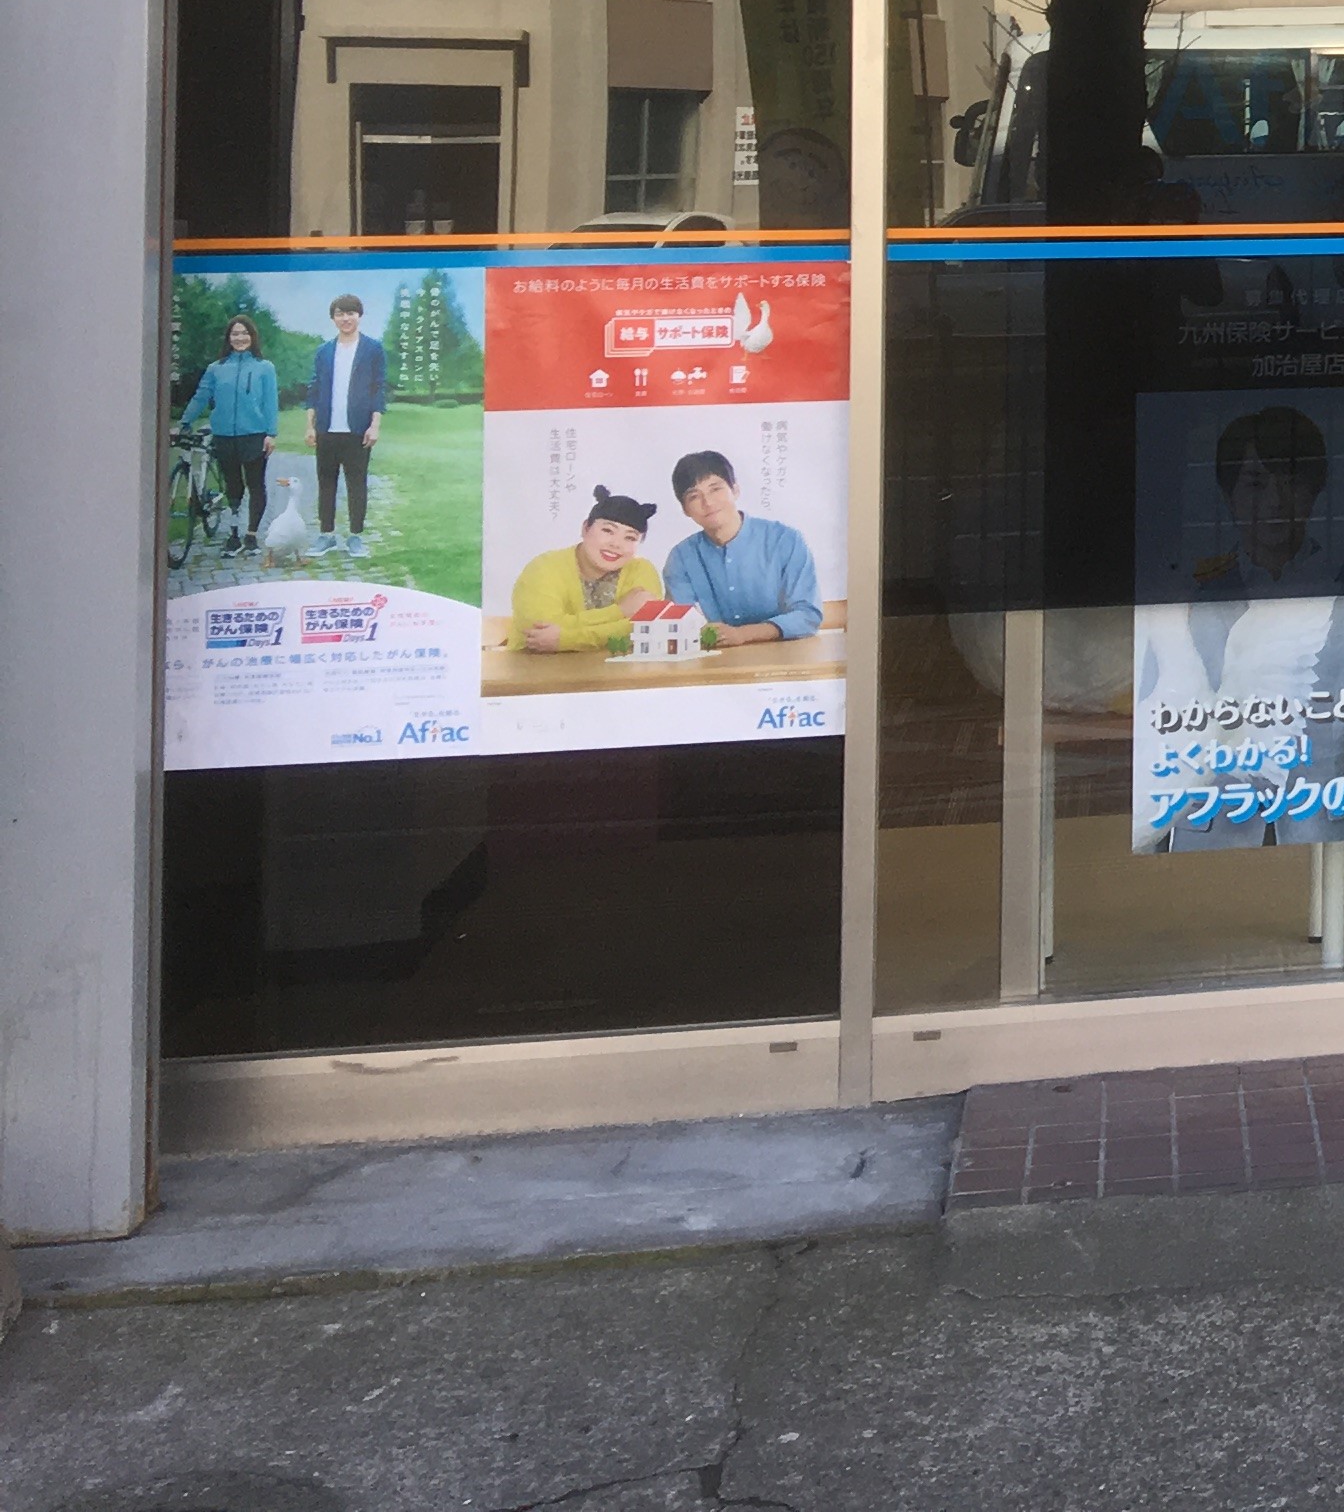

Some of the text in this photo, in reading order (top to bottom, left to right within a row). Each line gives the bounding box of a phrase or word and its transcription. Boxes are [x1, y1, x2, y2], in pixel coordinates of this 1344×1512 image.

[512, 273, 827, 294] お給料のように毎月の生活費をサポートする保険
[619, 324, 730, 341] 給与 サポート保険
[209, 611, 280, 623] 生きるための
[304, 607, 375, 620] 生きるための
[209, 623, 270, 636] がん保険
[305, 618, 365, 631] がん保険
[756, 705, 826, 730] Aflac
[397, 720, 470, 745] Aflac
[1149, 734, 1313, 776] よくわかる！
